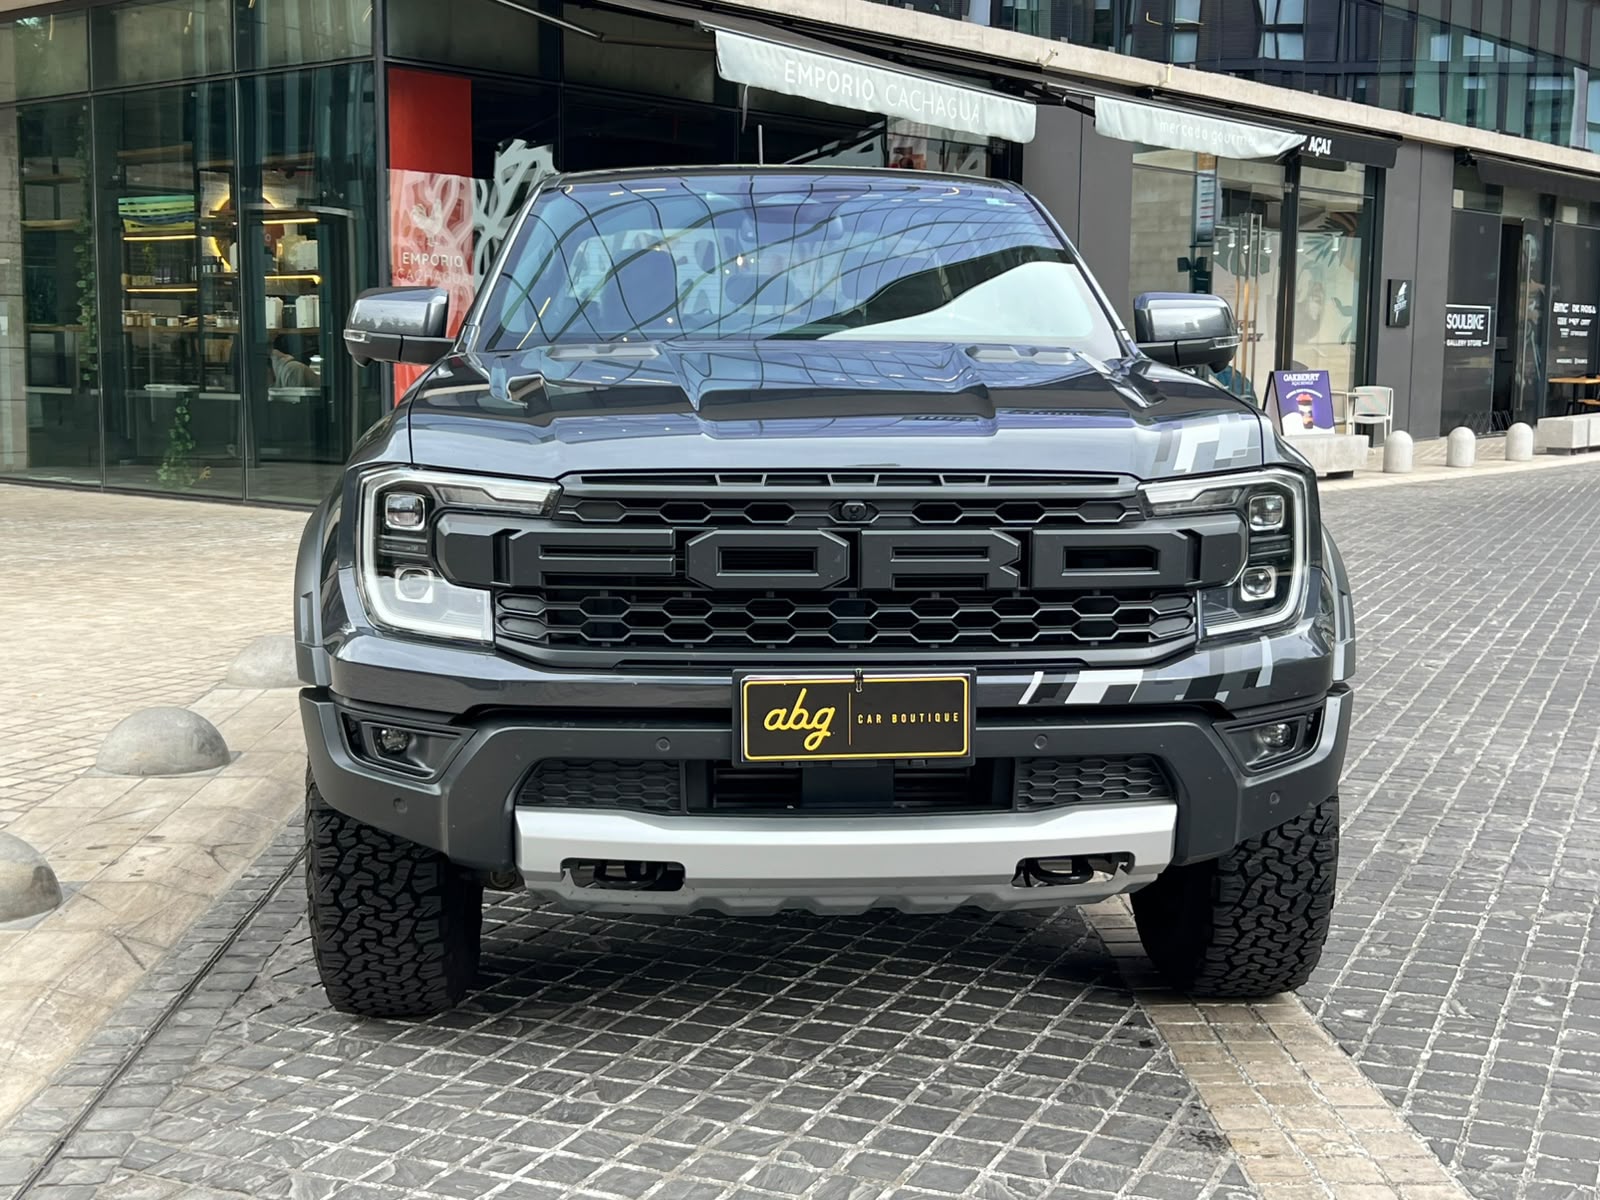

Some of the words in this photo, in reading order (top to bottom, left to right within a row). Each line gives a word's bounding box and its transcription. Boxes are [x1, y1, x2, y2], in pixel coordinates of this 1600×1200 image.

[784, 60, 875, 101] EMPORIO
[885, 82, 980, 123] CACHAGUA
[1159, 121, 1208, 141] mercado
[1308, 136, 1332, 157] AÇAI
[402, 251, 464, 267] EMPORIO
[396, 267, 469, 283] CACHAGUA
[1446, 313, 1485, 330] SOULBIKE
[1446, 339, 1467, 347] GALLERY
[1467, 339, 1482, 347] STORE
[509, 527, 1189, 592] FORD
[763, 687, 836, 751] abg
[857, 713, 883, 724] CAR
[891, 711, 960, 724] BOUTIQUE
